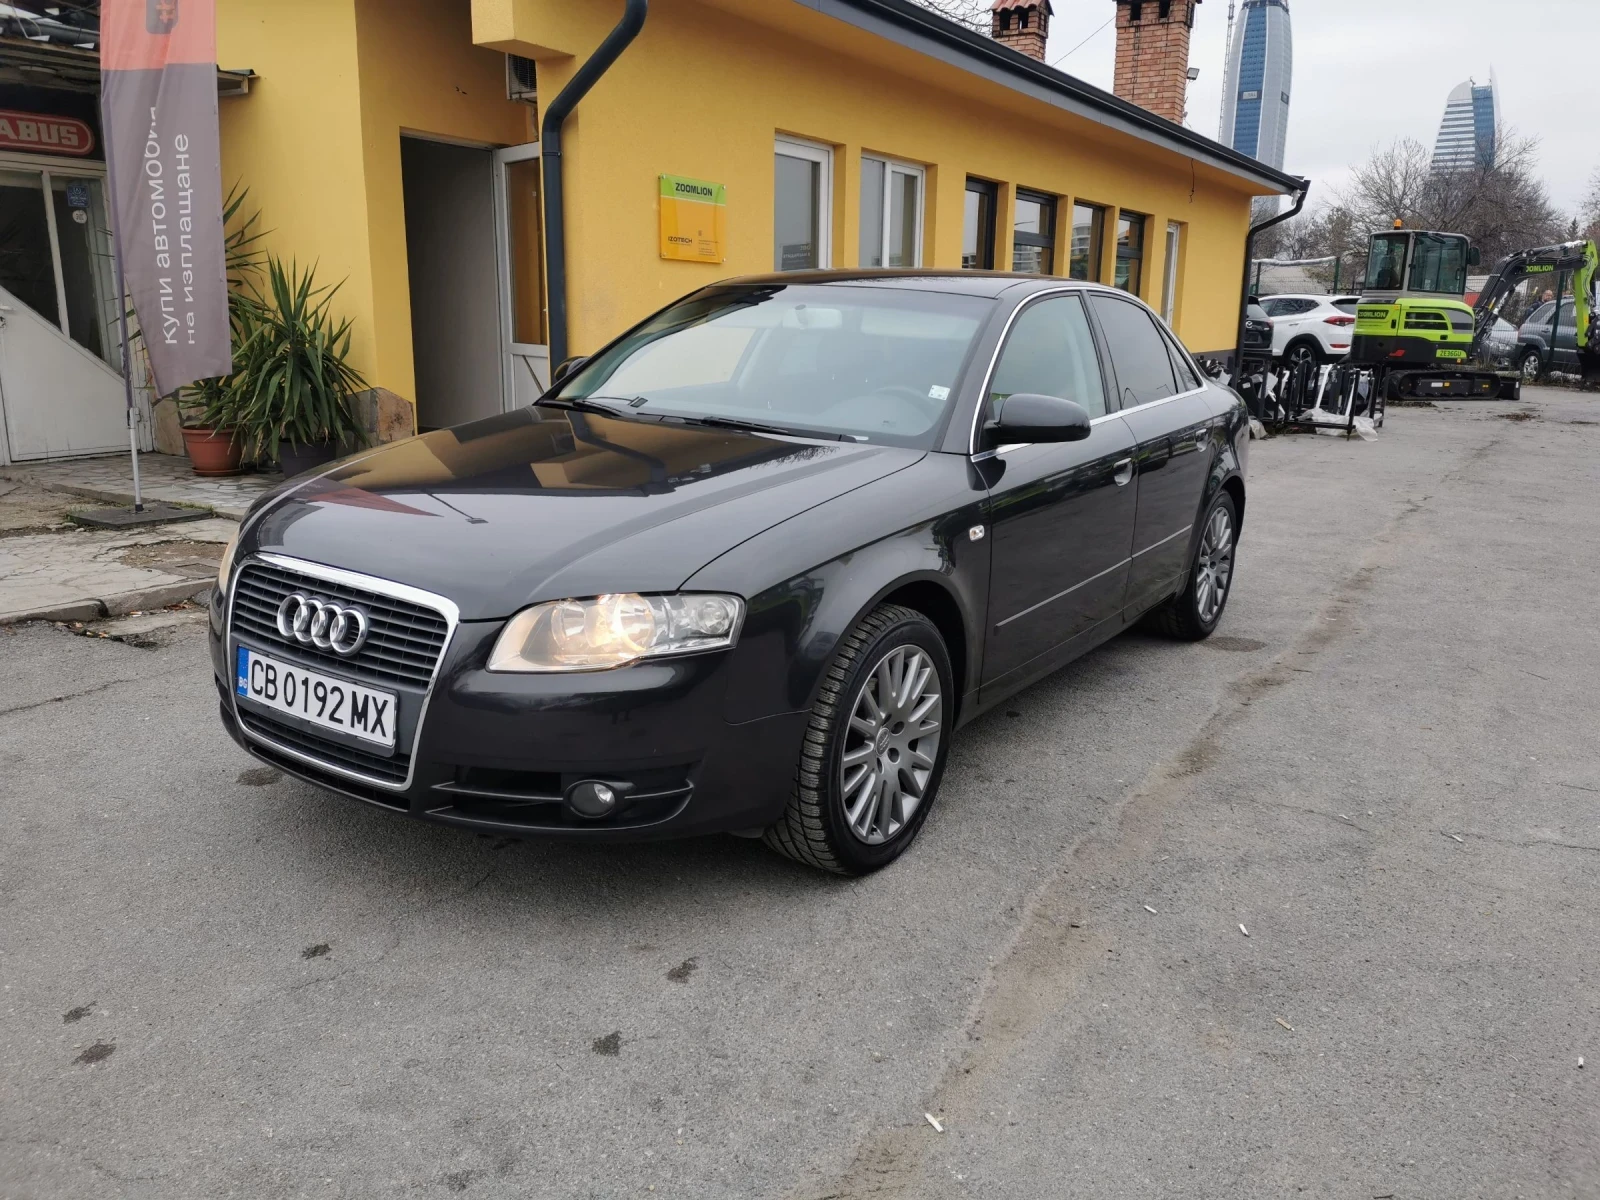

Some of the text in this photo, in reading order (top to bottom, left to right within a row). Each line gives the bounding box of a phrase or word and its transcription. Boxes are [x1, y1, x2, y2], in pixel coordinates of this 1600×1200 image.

[0, 119, 79, 146] ABUS
[675, 182, 713, 197] ZOOMLION
[174, 133, 195, 344] на изплащане
[668, 235, 693, 244] IZOTECH
[238, 675, 248, 689] BG
